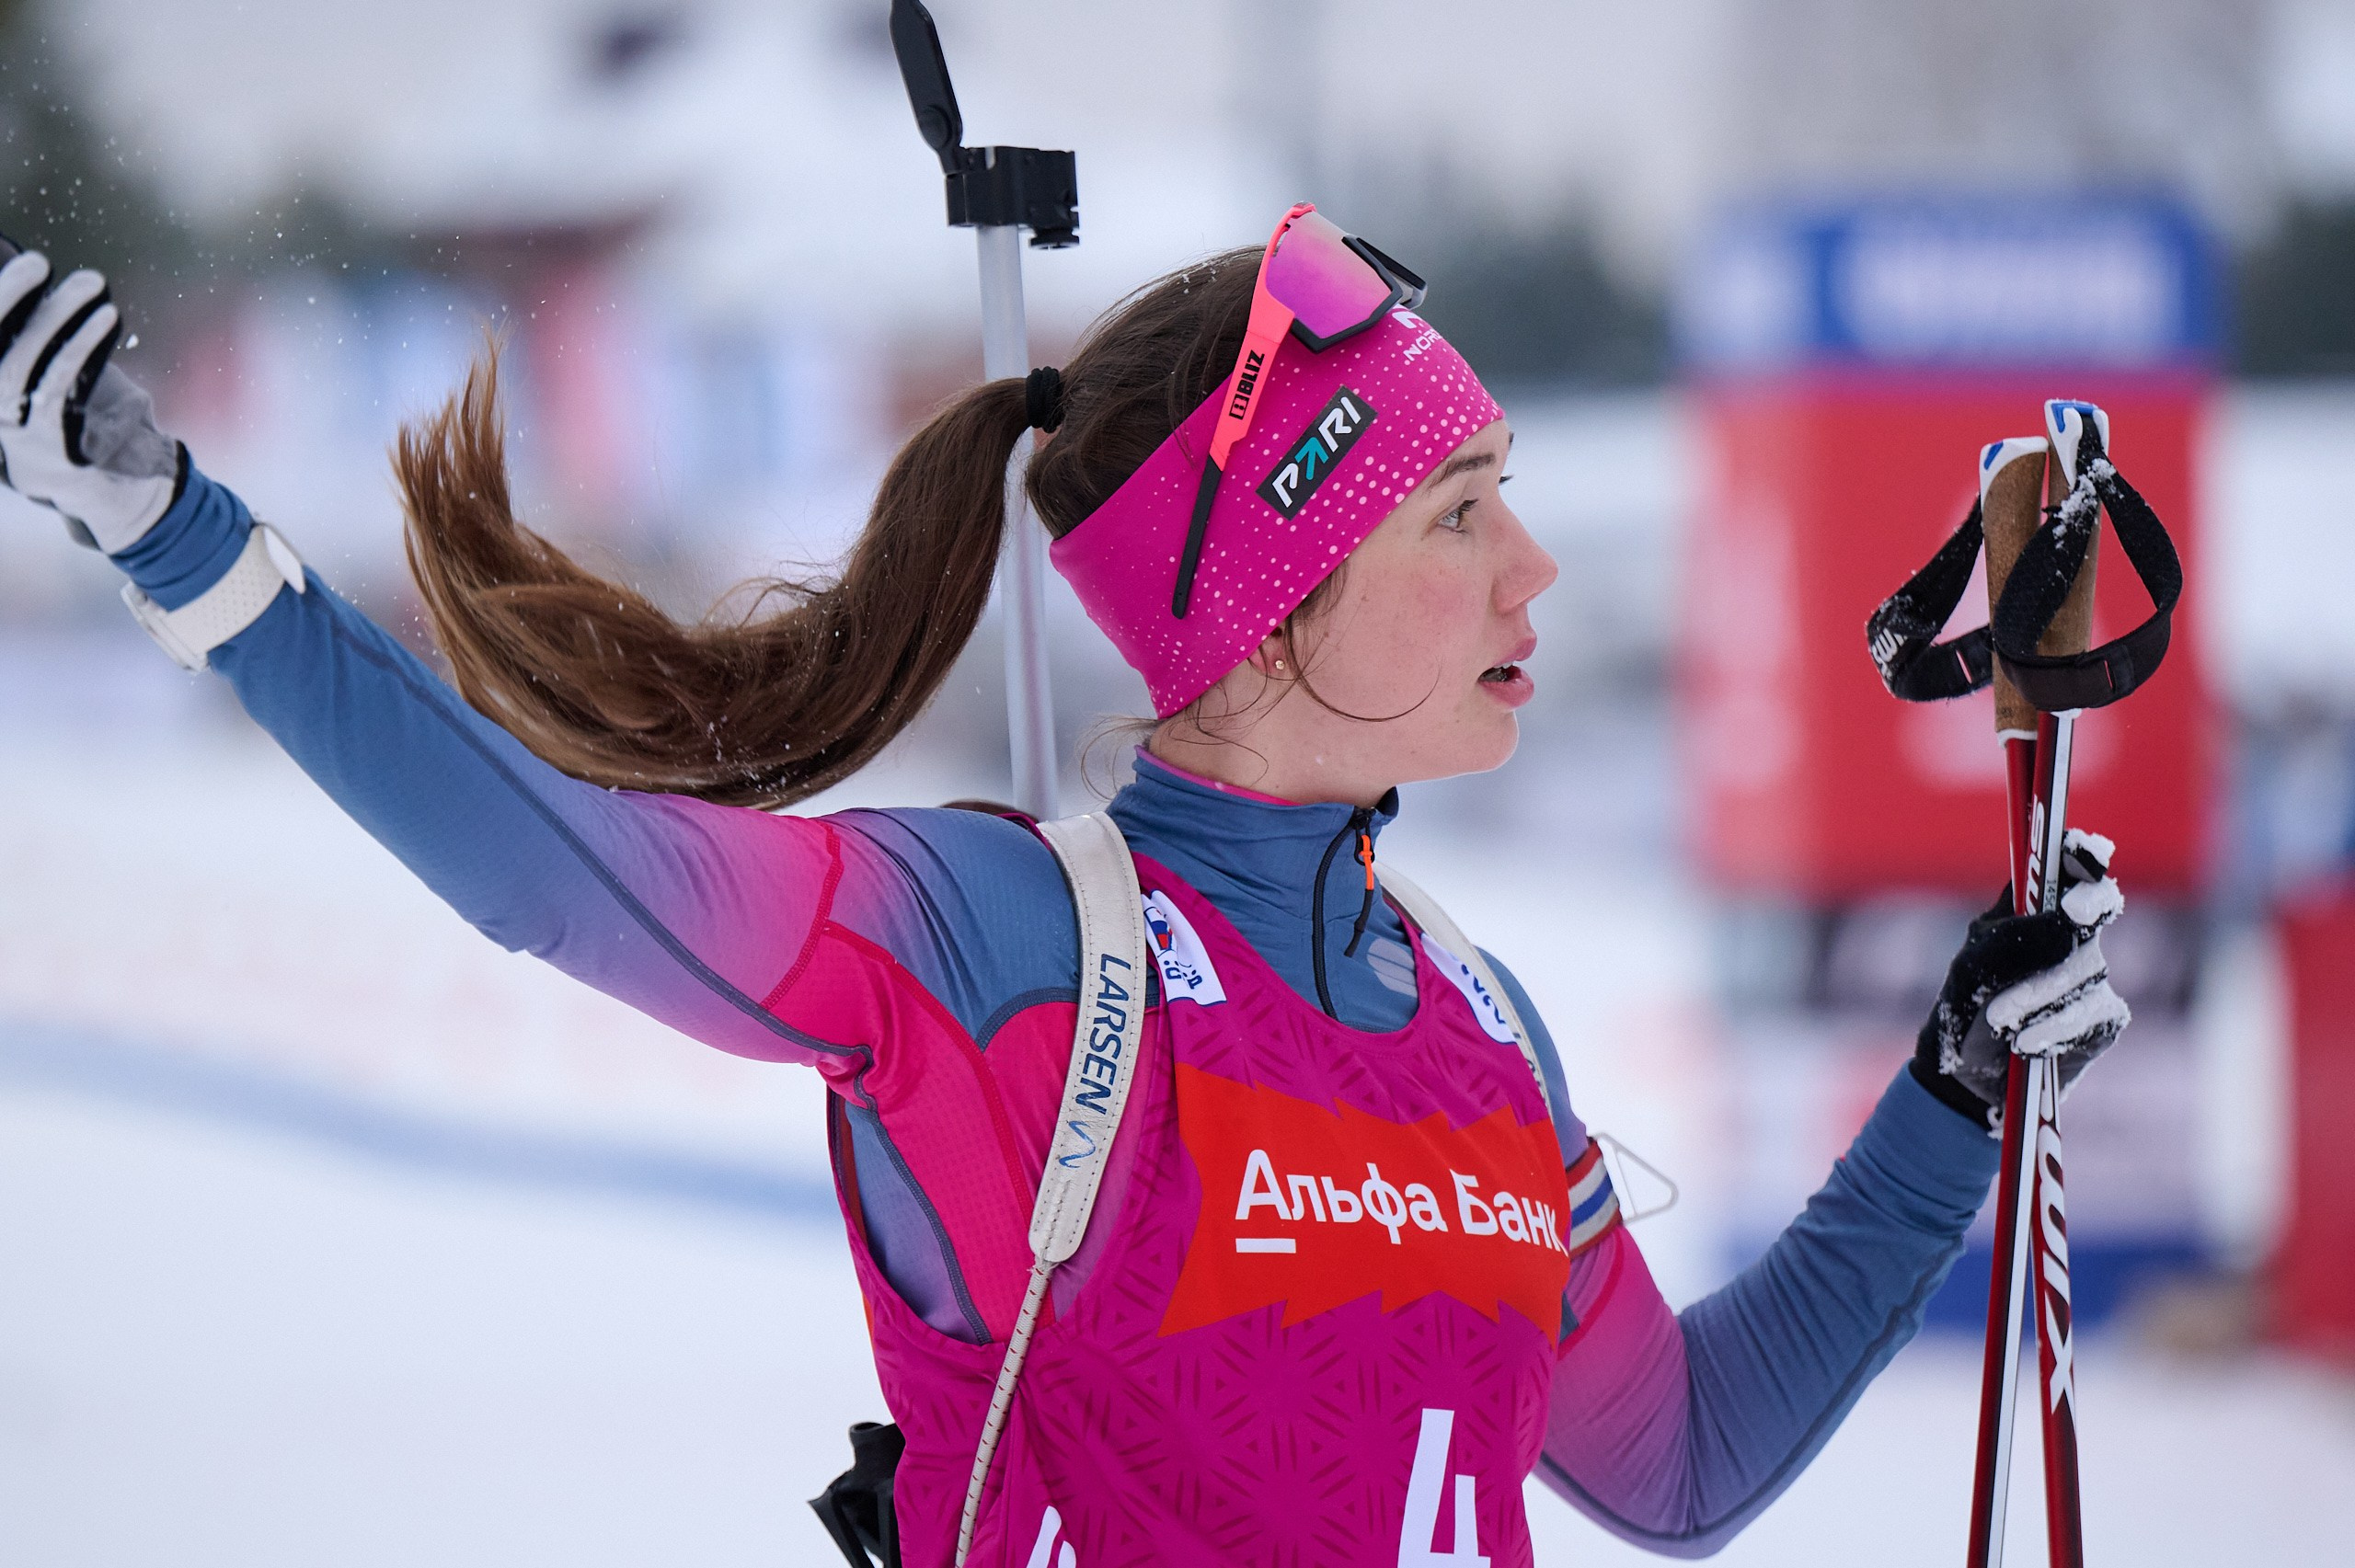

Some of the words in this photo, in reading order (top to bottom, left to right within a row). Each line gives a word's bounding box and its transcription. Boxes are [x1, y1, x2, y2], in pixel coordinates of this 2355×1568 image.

[1236, 349, 1265, 396] BLIZ
[2025, 794, 2045, 917] SW
[1074, 953, 1132, 1116] LARSEN
[1235, 1149, 1449, 1245] Альфа
[1449, 1168, 1568, 1258] Банк
[1396, 1407, 1492, 1568] 4
